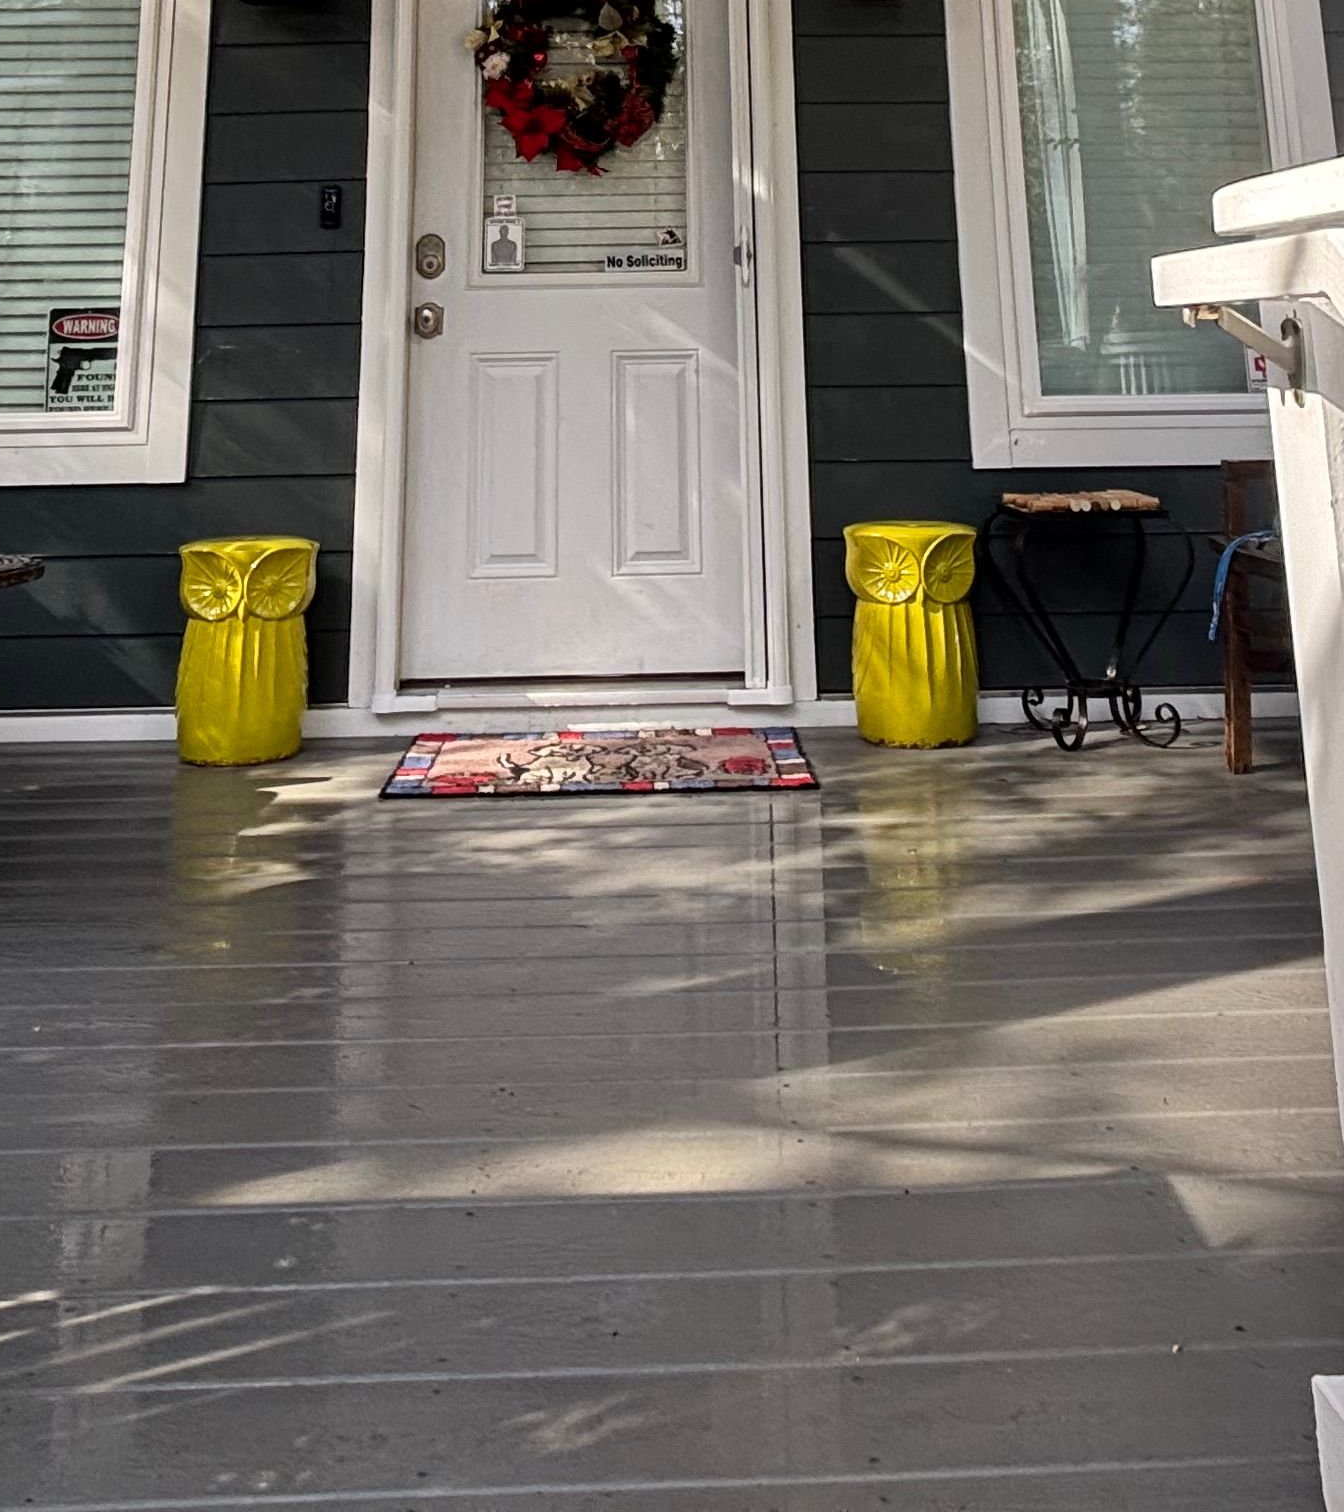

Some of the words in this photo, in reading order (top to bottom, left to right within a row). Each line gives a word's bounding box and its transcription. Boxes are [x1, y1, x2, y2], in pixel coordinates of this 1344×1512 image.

[607, 255, 623, 268] No
[626, 254, 682, 269] Soliciting
[63, 319, 116, 335] WARNING
[77, 373, 115, 382] FOUN
[48, 395, 73, 403] YOU
[76, 395, 105, 403] WILL
